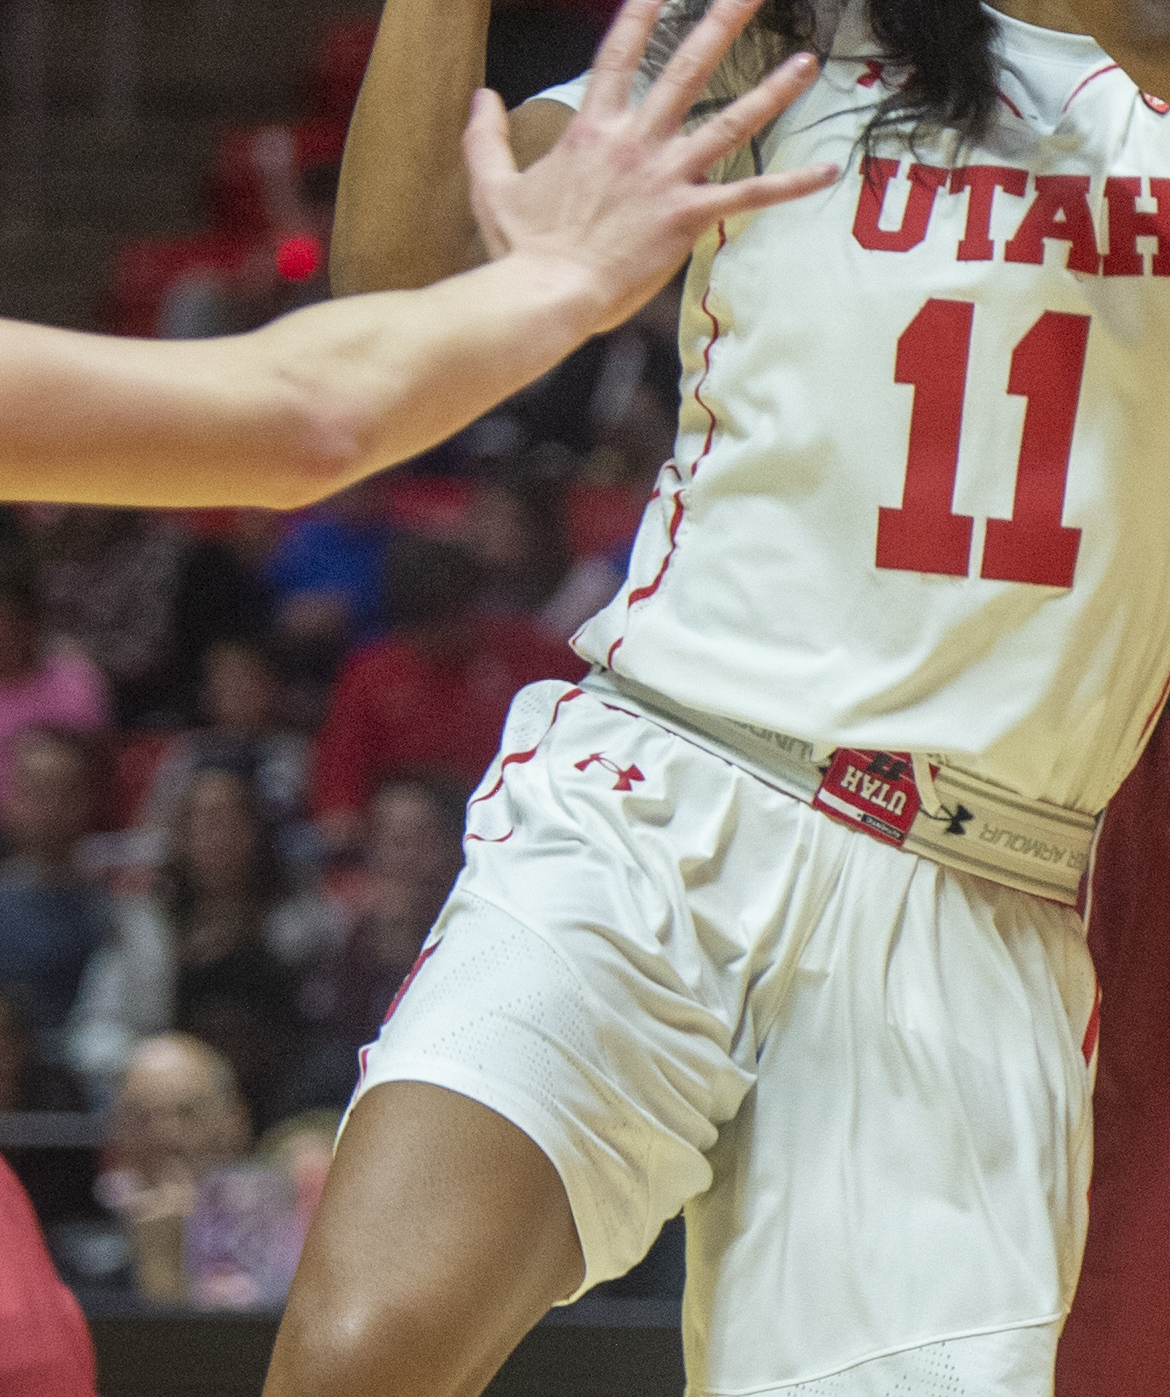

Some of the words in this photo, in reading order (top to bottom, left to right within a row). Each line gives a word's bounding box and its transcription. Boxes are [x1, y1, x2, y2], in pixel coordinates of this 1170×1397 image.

[875, 297, 1093, 589] 11
[839, 764, 908, 817] UTAH
[978, 823, 1068, 864] ARMOUR
